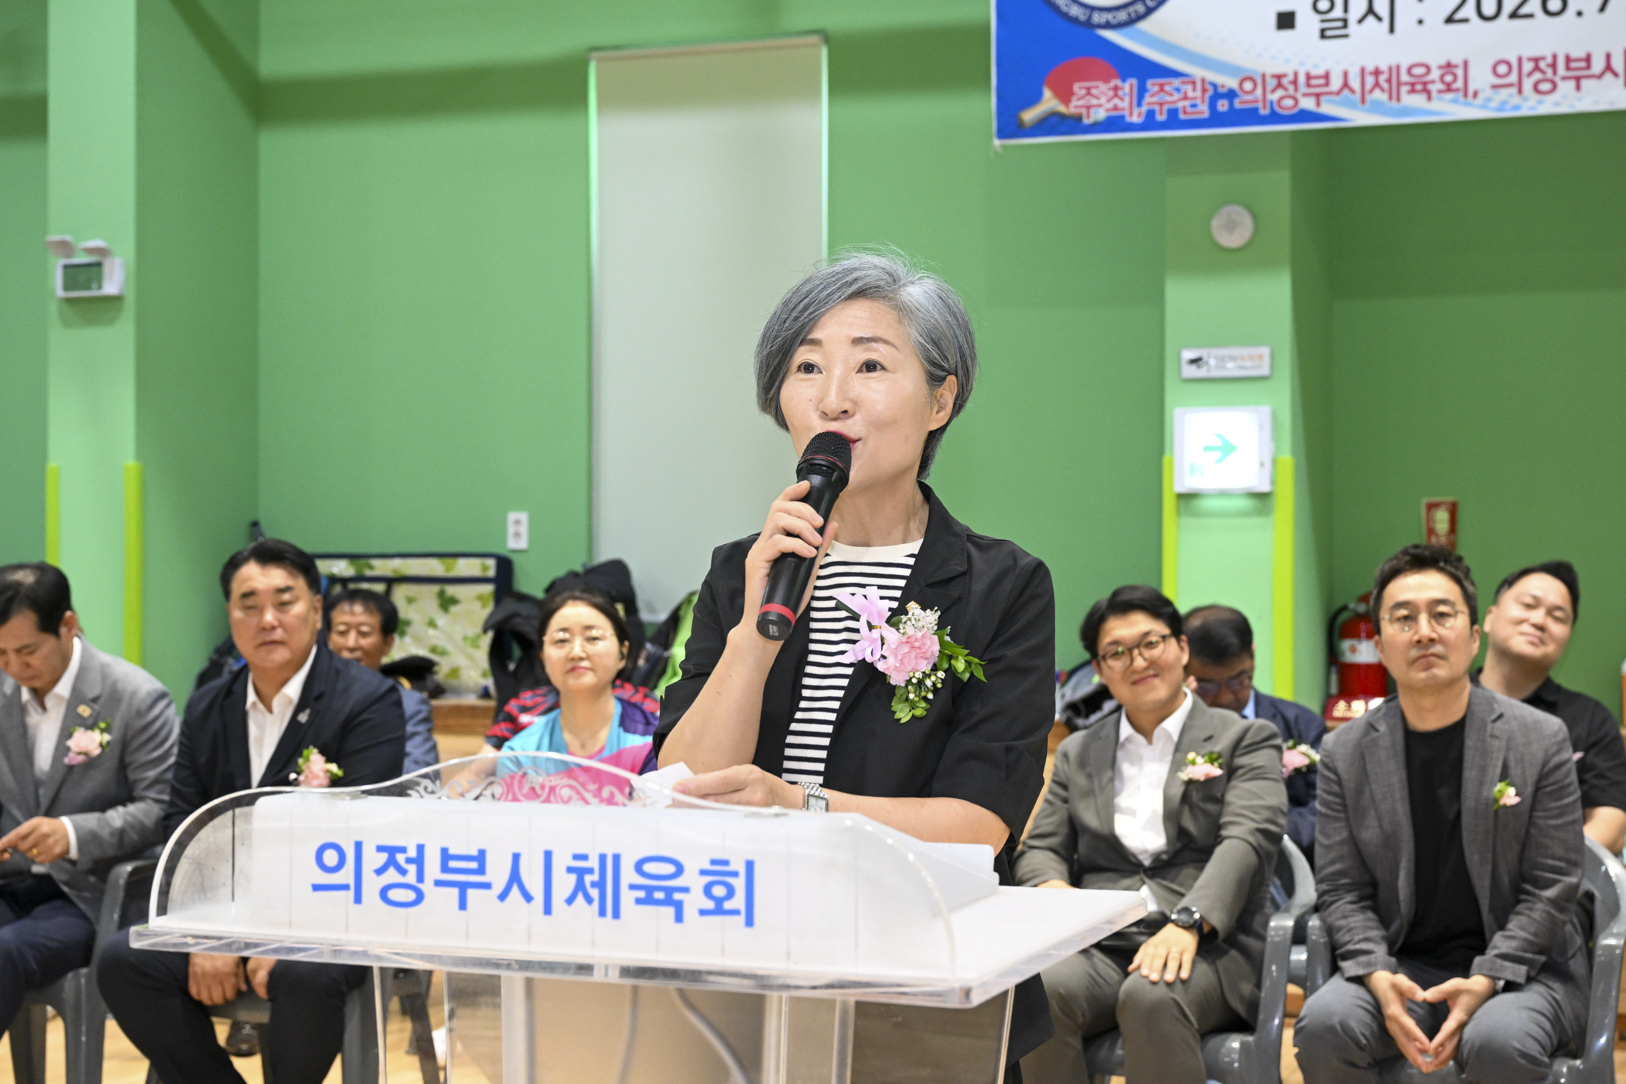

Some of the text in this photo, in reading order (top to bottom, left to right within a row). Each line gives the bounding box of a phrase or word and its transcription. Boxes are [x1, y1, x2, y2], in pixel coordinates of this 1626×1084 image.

[1090, 1, 1147, 25] SPORTS
[1312, 0, 1395, 40] 일시
[1071, 77, 1213, 122] 주최,주관
[1236, 58, 1478, 113] 의정부시체육회,
[311, 839, 755, 928] 의정부시체육회
